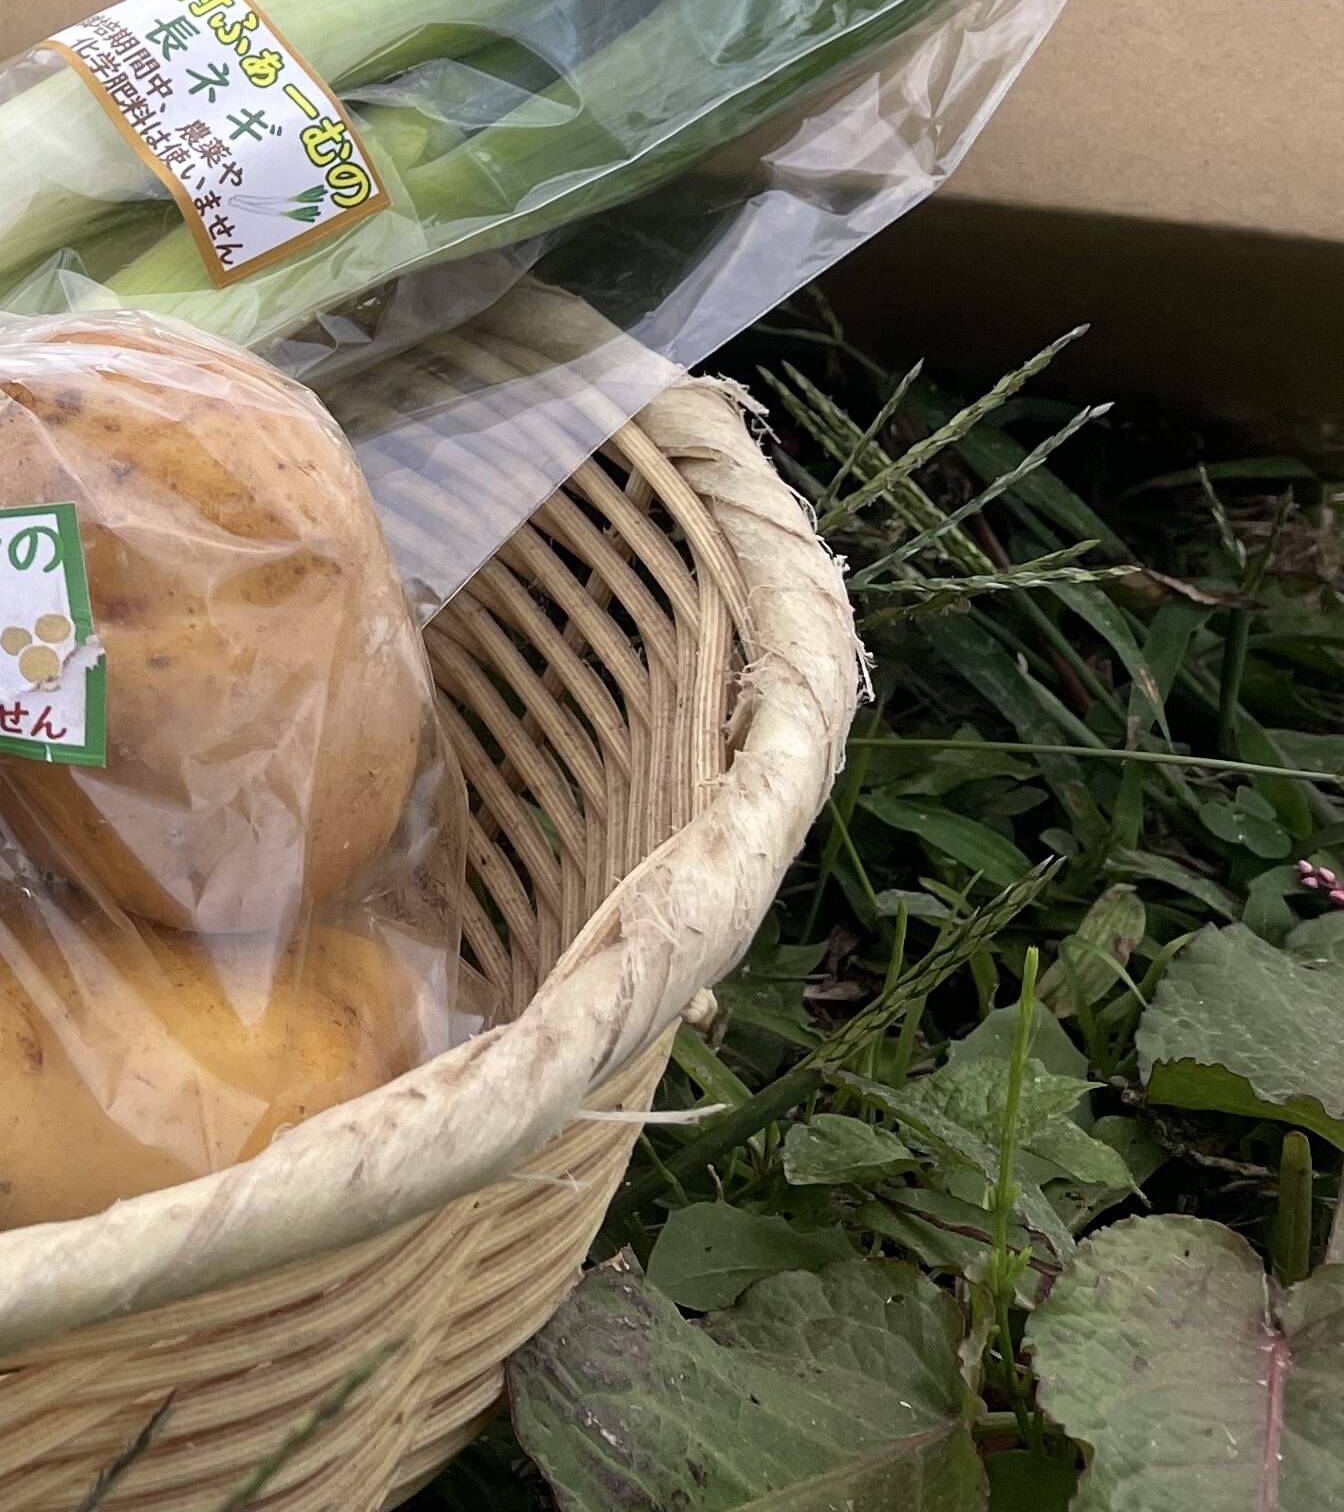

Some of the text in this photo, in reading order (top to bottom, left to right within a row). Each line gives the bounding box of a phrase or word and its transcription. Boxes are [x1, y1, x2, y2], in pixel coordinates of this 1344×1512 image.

[69, 37, 244, 265] 化学肥料は使いません
[145, 14, 283, 142] 長ネギ
